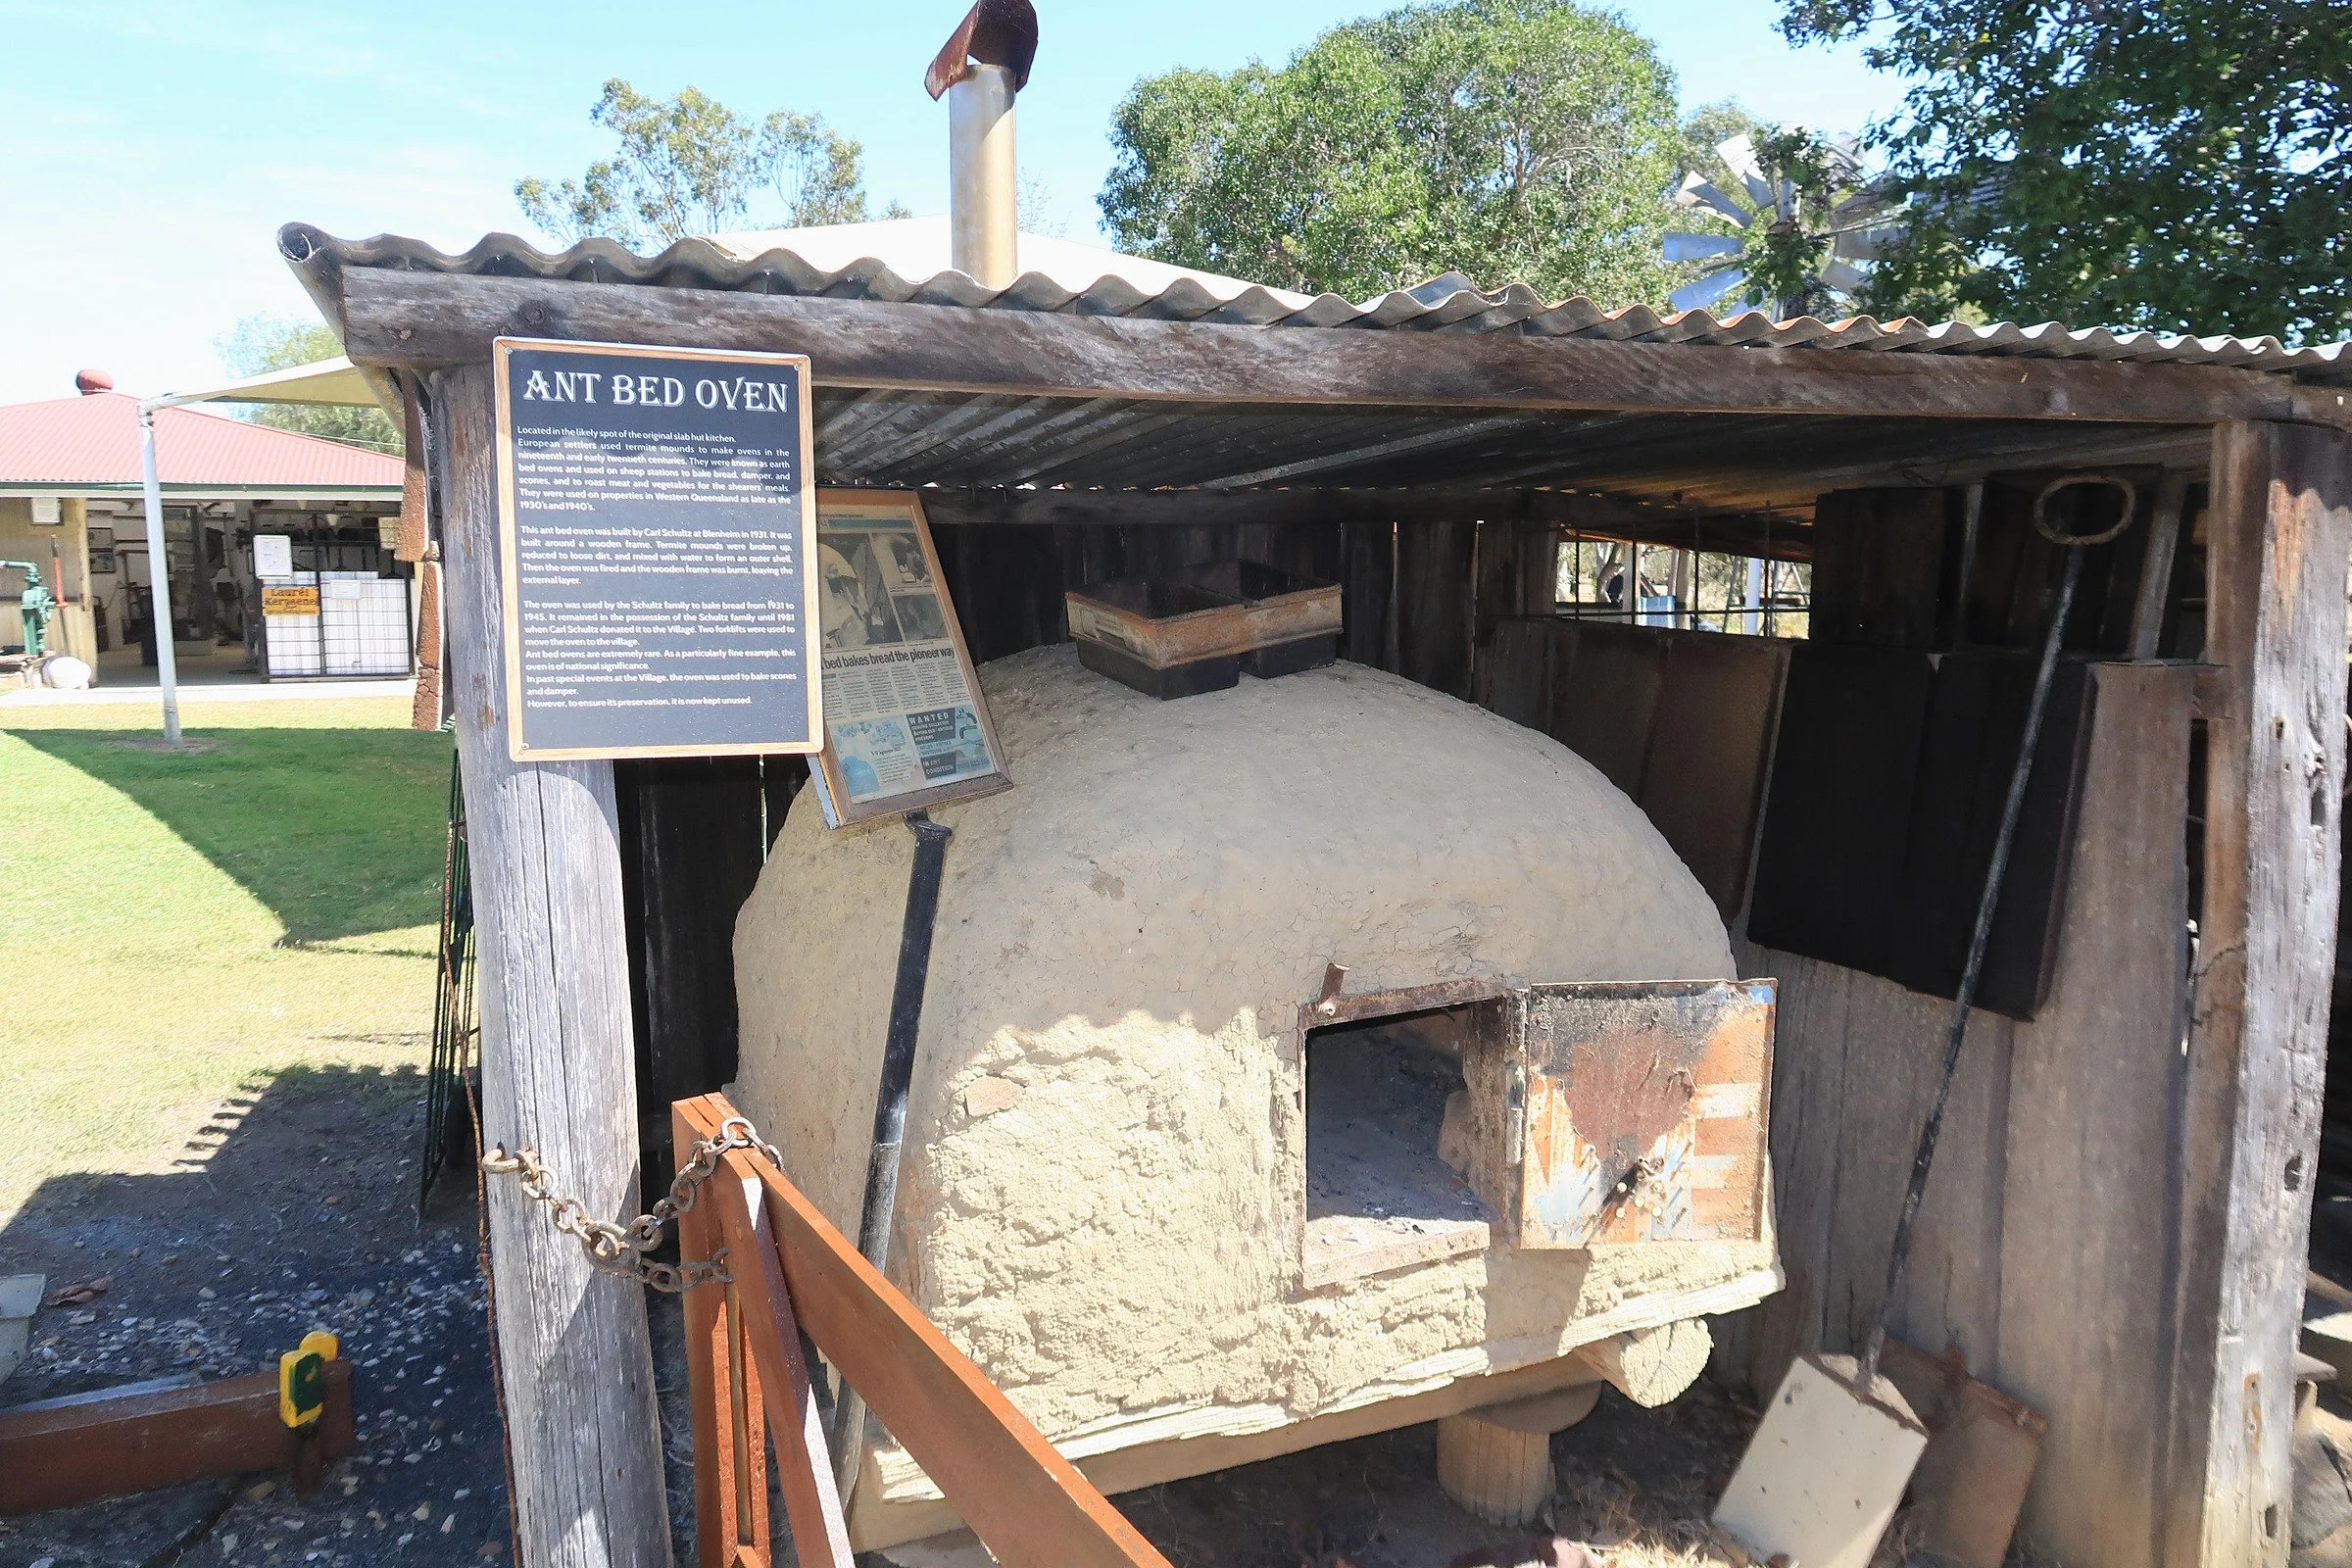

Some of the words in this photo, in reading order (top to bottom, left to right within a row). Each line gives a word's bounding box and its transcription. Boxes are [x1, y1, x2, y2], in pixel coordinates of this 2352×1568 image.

[522, 369, 602, 403] ANT
[612, 374, 686, 408] BED
[695, 376, 788, 413] OVEN
[517, 425, 551, 435] Located
[552, 426, 560, 435] in
[575, 427, 598, 439] likely
[599, 429, 617, 439] spot
[628, 429, 642, 438] the
[642, 430, 672, 441] original
[673, 431, 690, 440] slab
[690, 432, 704, 441] hut
[705, 433, 735, 442] kitchen.
[517, 438, 560, 450] European
[564, 439, 597, 449] settlers
[600, 441, 620, 450] used
[625, 442, 657, 451] termite
[660, 443, 694, 452] mounds
[710, 445, 733, 454] make
[776, 447, 789, 456] the
[517, 451, 564, 460] nineteenth
[565, 452, 582, 461] and
[583, 453, 606, 464] early
[607, 454, 647, 463] twentieth
[647, 455, 688, 465] centuries.
[689, 457, 709, 466] They
[731, 458, 758, 466] known
[768, 459, 789, 467] earth
[518, 463, 535, 471] bed
[583, 465, 604, 473] used
[619, 466, 645, 477] sheep
[646, 466, 679, 476] stations
[692, 468, 711, 477] bake
[553, 476, 569, 485] and
[632, 478, 649, 487] and
[651, 479, 695, 490] vegetables
[697, 480, 710, 489] for
[764, 482, 790, 491] meals.
[518, 488, 541, 499] They
[564, 489, 586, 498] used
[600, 490, 644, 502] properties
[645, 491, 653, 500] in
[690, 492, 739, 502] Queensland
[548, 501, 564, 510] and
[520, 537, 541, 546] built
[544, 538, 575, 547] around
[624, 539, 652, 548] frame.
[655, 540, 687, 549] Termite
[521, 550, 557, 559] reduced
[660, 552, 678, 561] with
[604, 600, 615, 611] by
[615, 600, 630, 609] the
[631, 600, 662, 609] Schultz
[663, 601, 690, 611] family
[523, 612, 547, 620] 1945.
[625, 612, 670, 622] possession
[729, 612, 756, 622] family
[525, 649, 541, 658] Ant
[600, 649, 643, 659] extremely
[681, 649, 727, 659] particularly
[823, 657, 843, 669] bed
[843, 655, 870, 668] bakes
[869, 652, 895, 664] bread
[895, 650, 909, 662] the
[909, 648, 939, 662] pioneer
[939, 647, 955, 659] way
[908, 711, 949, 725] WANTED
[925, 764, 955, 774] CONDITION
